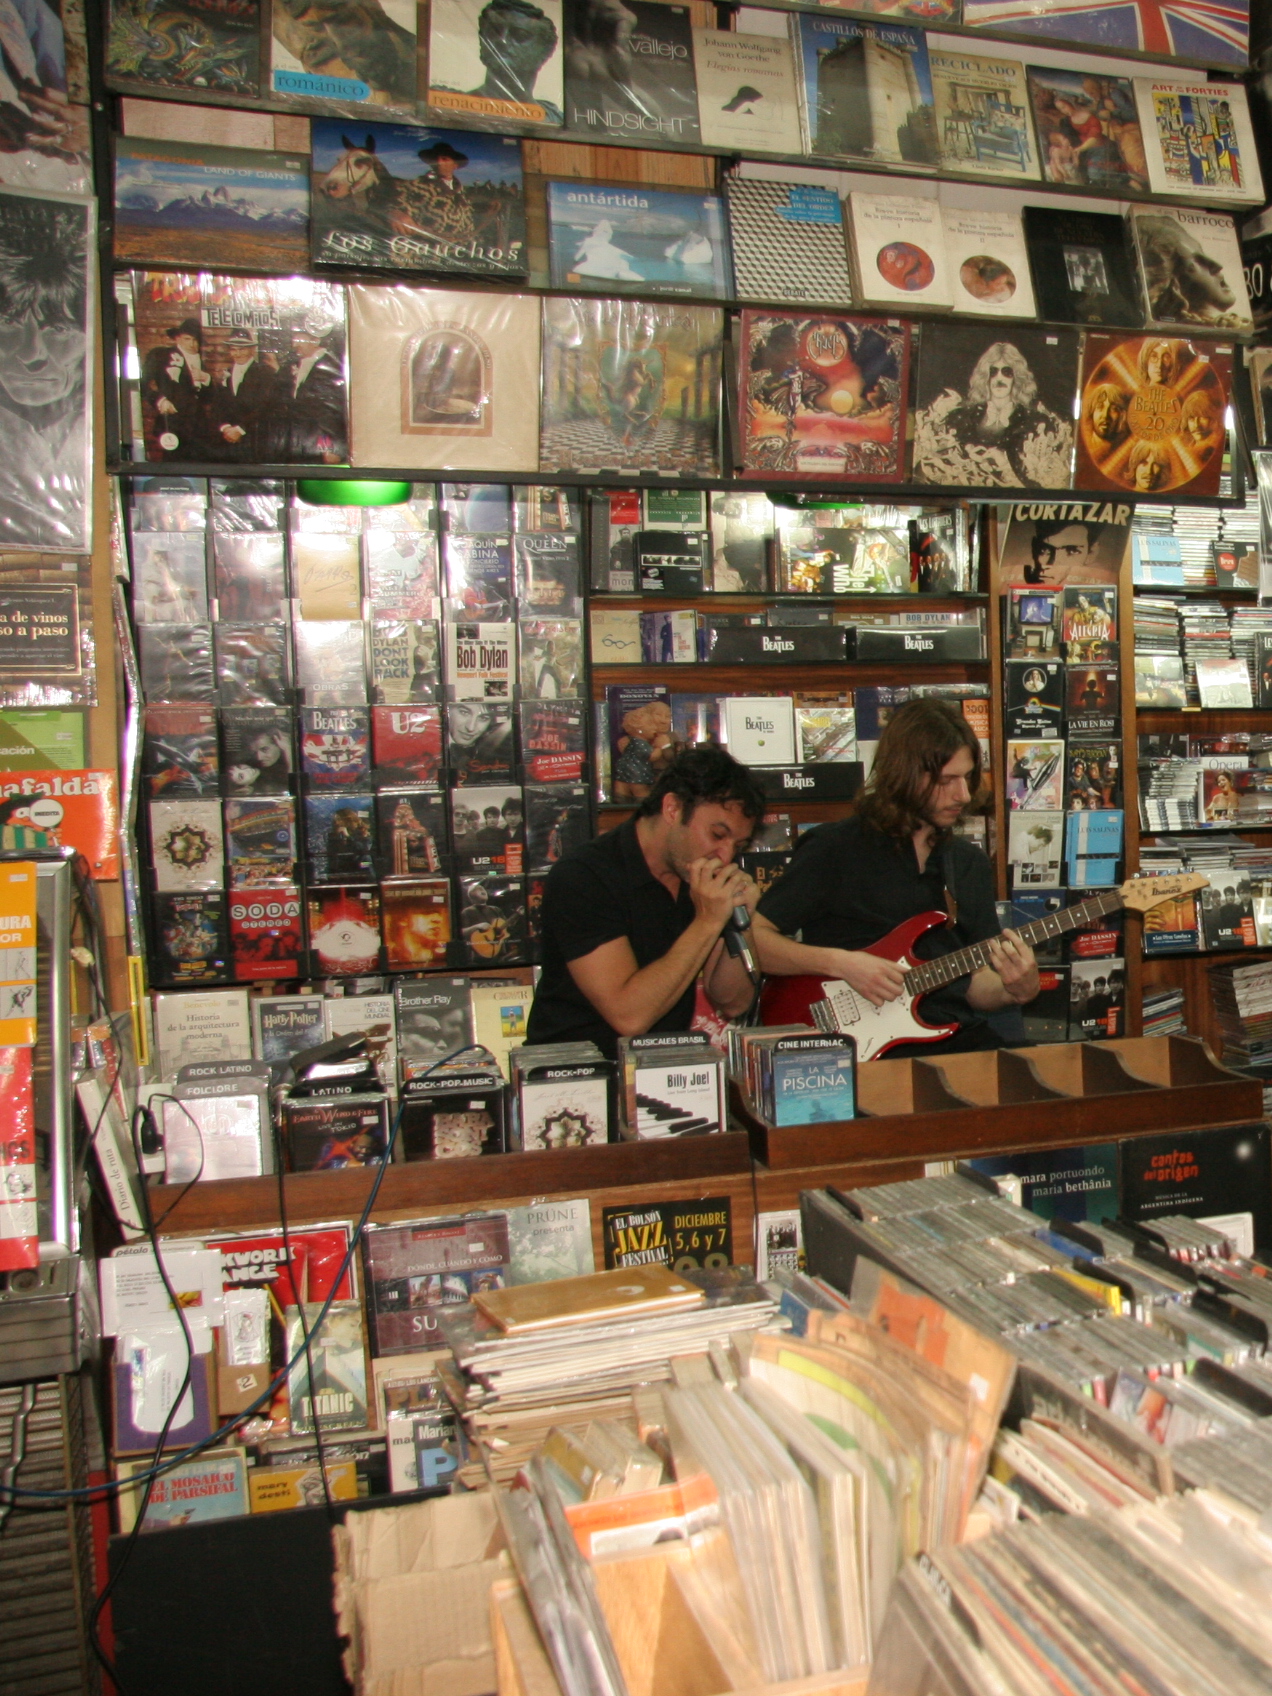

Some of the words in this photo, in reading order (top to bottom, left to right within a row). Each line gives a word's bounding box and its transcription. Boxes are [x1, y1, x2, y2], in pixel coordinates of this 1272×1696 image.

[813, 20, 865, 38] CASTILLOS
[866, 28, 879, 41] DE
[880, 29, 916, 45] ESPAÑA
[628, 39, 688, 61] vallejo
[703, 36, 735, 50] Johann
[737, 41, 783, 56] Wolfgang
[718, 50, 734, 61] von
[736, 51, 771, 63] Goethe
[931, 55, 1017, 78] RECICLADO
[277, 75, 365, 98] románico
[1151, 83, 1174, 93] ART
[1186, 86, 1230, 97] FORTIES
[432, 93, 543, 119] renacimiento
[574, 108, 687, 134] HINDSIGHT
[204, 166, 234, 177] LAND
[256, 171, 296, 182] GIANTS
[567, 190, 649, 209] antártida
[1178, 209, 1235, 229] barroco
[1149, 388, 1167, 400] THE
[1146, 416, 1165, 431] 20
[1016, 501, 1131, 527] CORTAZAR
[522, 535, 569, 555] QUEEN
[833, 564, 850, 593] Who
[12, 611, 28, 623] de
[32, 611, 68, 623] vinos
[18, 627, 27, 637] a
[31, 626, 68, 640] paso
[373, 638, 408, 647] DYLAN
[762, 636, 795, 653] BEATLES
[904, 636, 934, 652] BEATLES
[373, 648, 408, 657] DONT
[456, 645, 477, 669] Bob
[480, 646, 508, 672] Dylan
[374, 658, 409, 667] LOOK
[312, 683, 349, 692] OBRAS
[313, 711, 357, 732] BEATLES
[391, 711, 428, 734] U2
[745, 717, 775, 733] BEATLES
[536, 756, 550, 765] Joe
[550, 753, 582, 763] DASSIN
[783, 773, 815, 790] BEATLES
[472, 856, 490, 865] U2
[232, 902, 299, 920] SODA
[0, 915, 31, 930] URA
[242, 919, 291, 928] STEREO
[0, 933, 22, 943] OR
[1091, 932, 1117, 941] DASSIN
[1219, 928, 1232, 936] U2
[401, 996, 433, 1006] Brother
[434, 994, 451, 1006] Ray
[186, 1012, 221, 1022] Historia
[263, 1014, 289, 1029] Harry
[290, 1012, 318, 1026] Potter
[1081, 1019, 1096, 1027] U2
[167, 1024, 177, 1032] de
[189, 1021, 240, 1033] arquitectura
[186, 1031, 223, 1040] moderna
[632, 1036, 677, 1047] MUSICALES
[678, 1035, 706, 1045] BRASIL
[778, 1039, 800, 1049] CINE
[189, 1065, 218, 1077] ROCK
[219, 1063, 253, 1075] LATINO
[547, 1067, 596, 1079] ROCK-POP
[809, 1066, 820, 1074] LA
[667, 1073, 688, 1089] Billy
[690, 1071, 710, 1087] Joel
[783, 1072, 847, 1092] PISCINA
[186, 1083, 239, 1097] FOLCLORE
[312, 1086, 353, 1097] LATINO
[1151, 1150, 1195, 1168] cantos
[1049, 1164, 1105, 1183] portuondo
[1157, 1164, 1199, 1183] origen
[1032, 1184, 1063, 1197] maria
[1065, 1177, 1112, 1193] bethânia
[118, 1181, 130, 1212] Diario
[1140, 1200, 1174, 1210] ARGENTINA
[615, 1217, 628, 1230] EL
[629, 1209, 662, 1228] BOLSÓN
[674, 1211, 727, 1229] DICIEMBRE
[533, 1224, 575, 1237] presenta
[613, 1221, 668, 1255] JAZZ
[718, 1228, 727, 1245] 7
[115, 1246, 149, 1257] pétalo
[621, 1246, 669, 1267] FESTIVAL
[412, 1315, 438, 1333] SU
[241, 1376, 252, 1388] 2
[421, 1447, 459, 1487] P
[171, 1472, 235, 1490] MOSAICO
[257, 1482, 288, 1493] mary
[172, 1482, 239, 1501] PARSIFAL
[258, 1488, 291, 1500] desti
